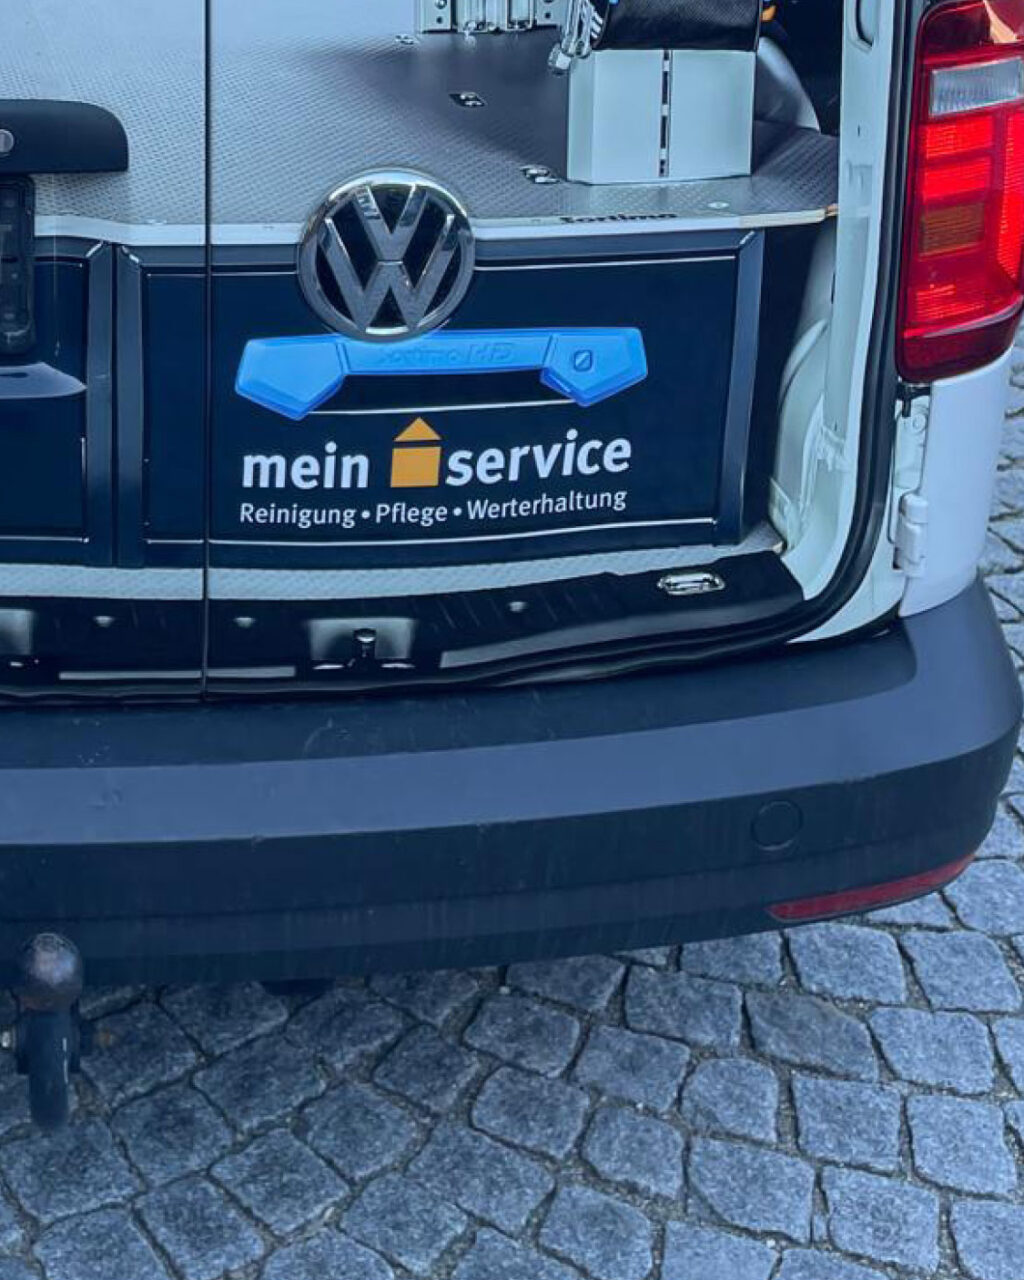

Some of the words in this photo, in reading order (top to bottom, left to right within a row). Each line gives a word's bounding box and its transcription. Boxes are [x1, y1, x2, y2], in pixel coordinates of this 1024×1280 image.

[242, 441, 369, 489] mein
[445, 428, 632, 487] service
[240, 502, 357, 528] Reinigung
[375, 502, 448, 526] Pflege
[466, 488, 628, 520] Werterhaltung
